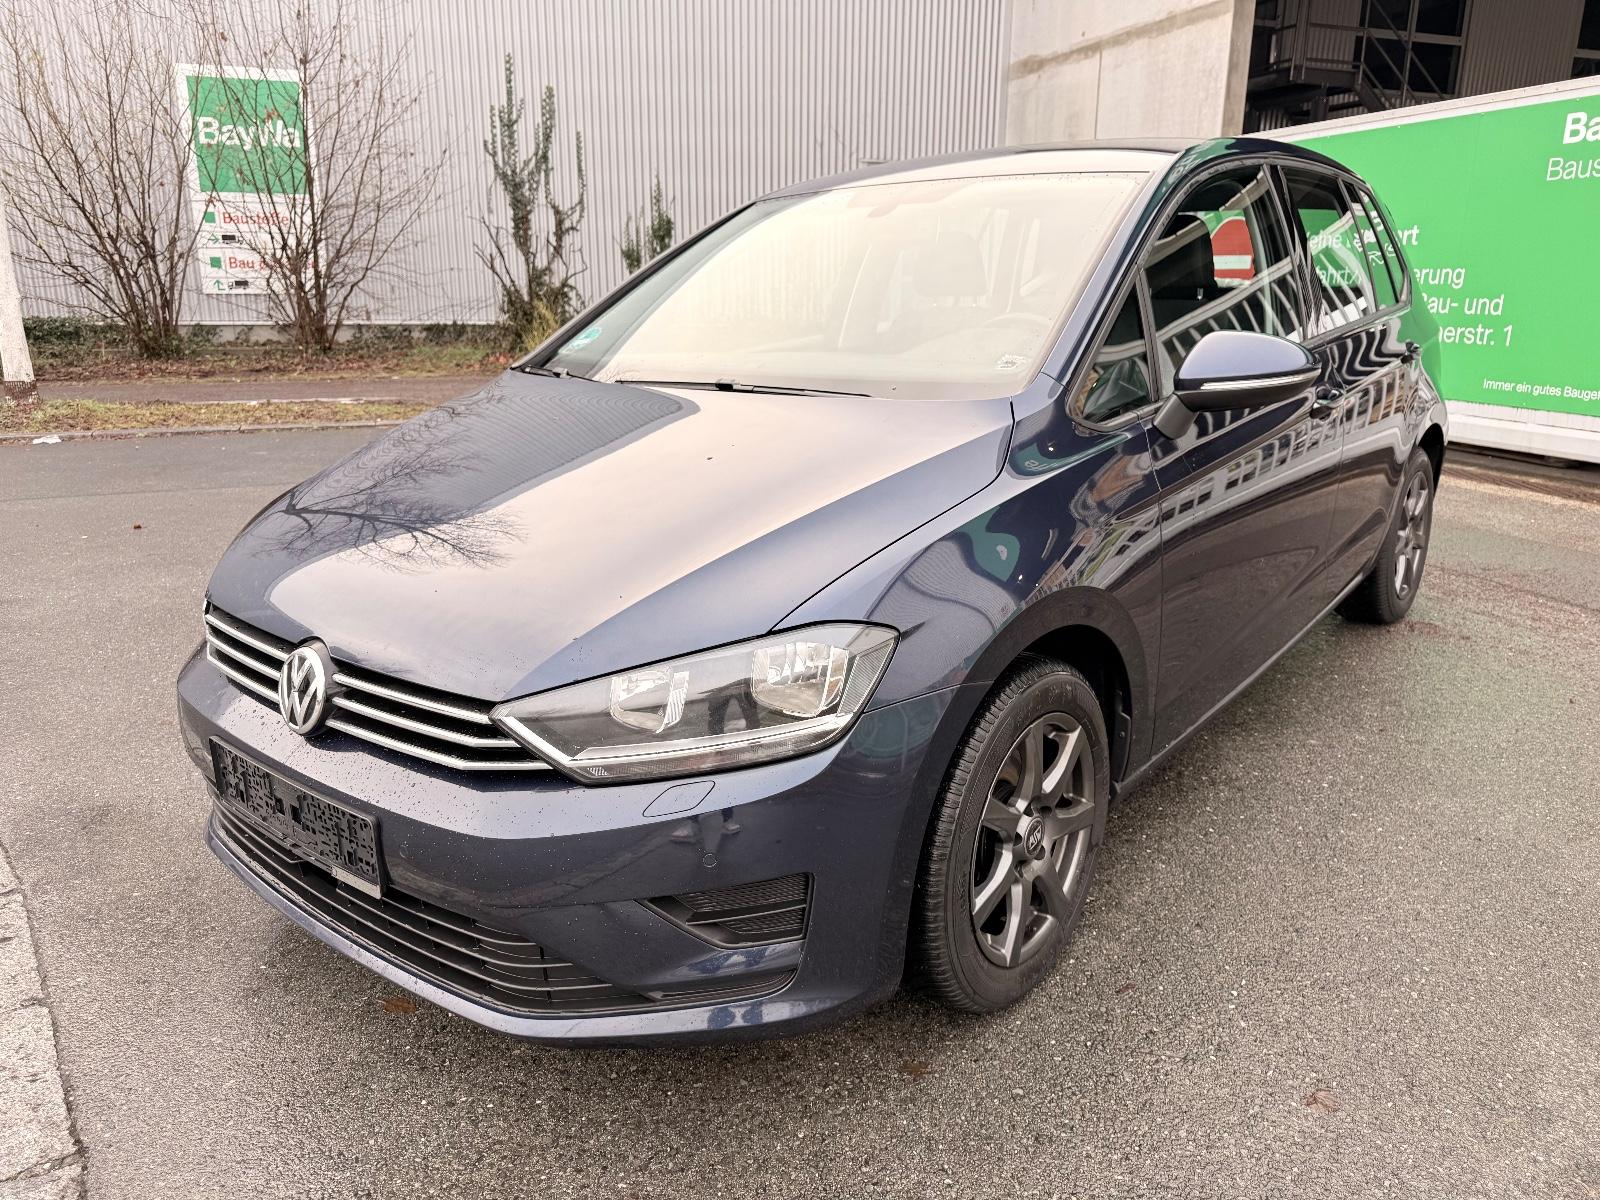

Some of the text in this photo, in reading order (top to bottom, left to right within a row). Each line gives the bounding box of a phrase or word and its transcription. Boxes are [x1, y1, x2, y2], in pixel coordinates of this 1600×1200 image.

[1546, 157, 1600, 181] Baus
[1398, 225, 1419, 245] rt
[229, 257, 255, 269] Bau
[1422, 293, 1504, 315] au- und
[1503, 325, 1513, 347] 1
[1483, 378, 1516, 392] Immer
[1516, 382, 1531, 393] ein
[1532, 384, 1561, 397] gutes
